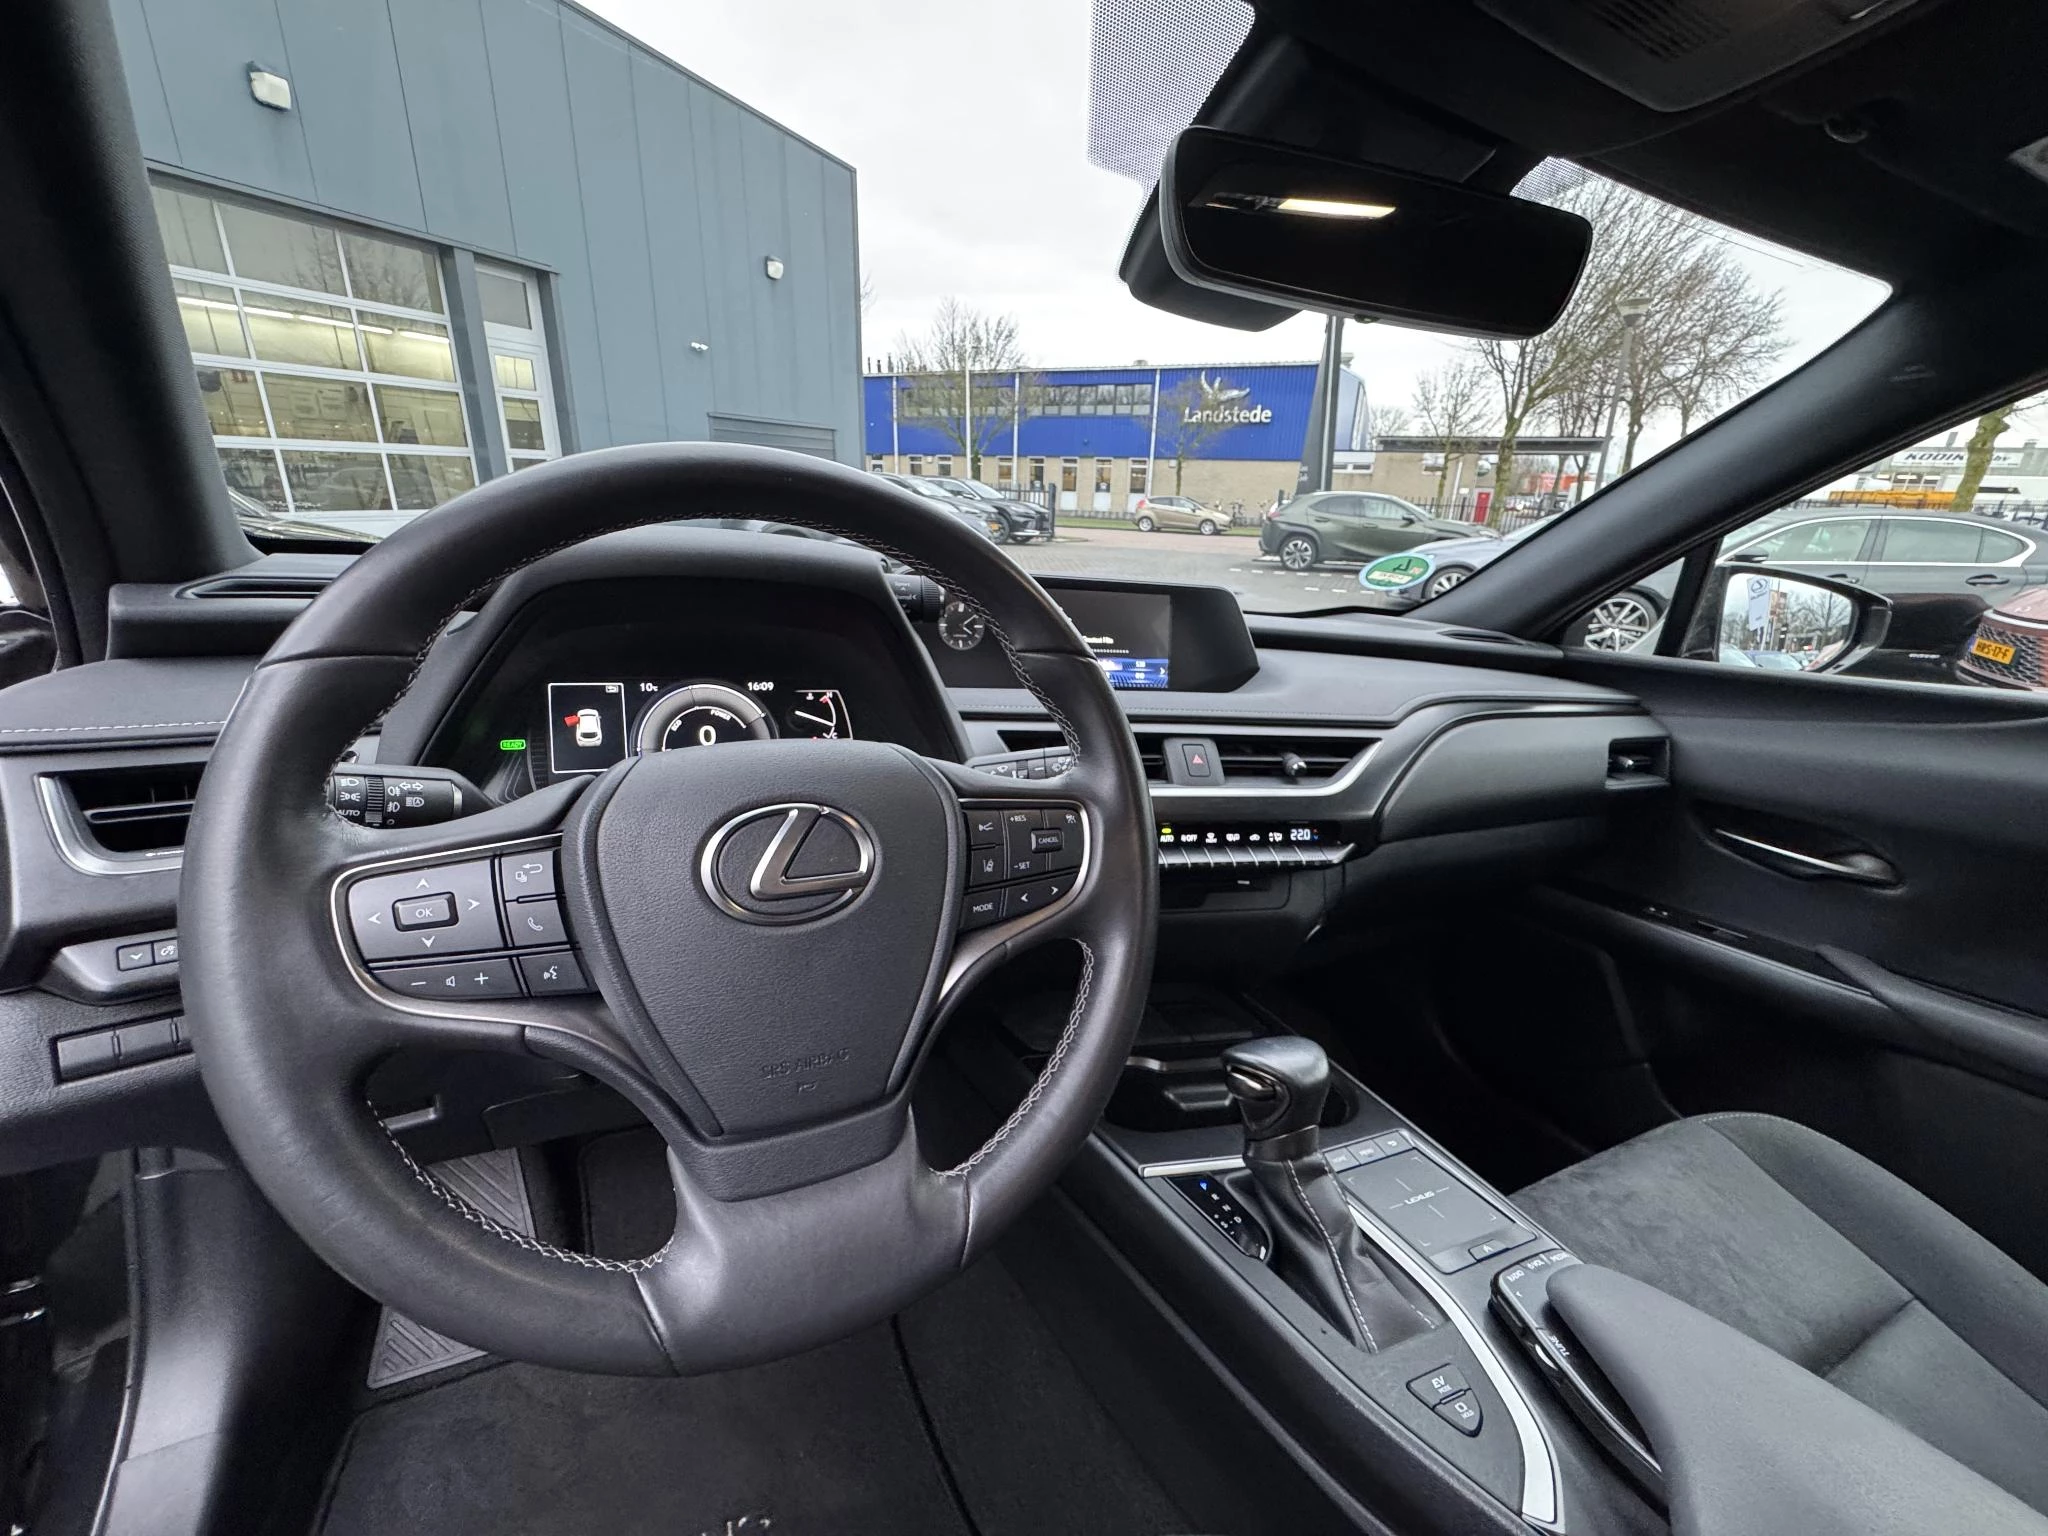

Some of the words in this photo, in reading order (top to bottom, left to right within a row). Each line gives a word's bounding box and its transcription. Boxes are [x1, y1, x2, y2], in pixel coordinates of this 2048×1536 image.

[1183, 405, 1272, 423] Landstede
[501, 741, 524, 749] READY
[416, 907, 433, 918] OK
[973, 902, 993, 913] MODE
[1431, 1375, 1446, 1389] EV
